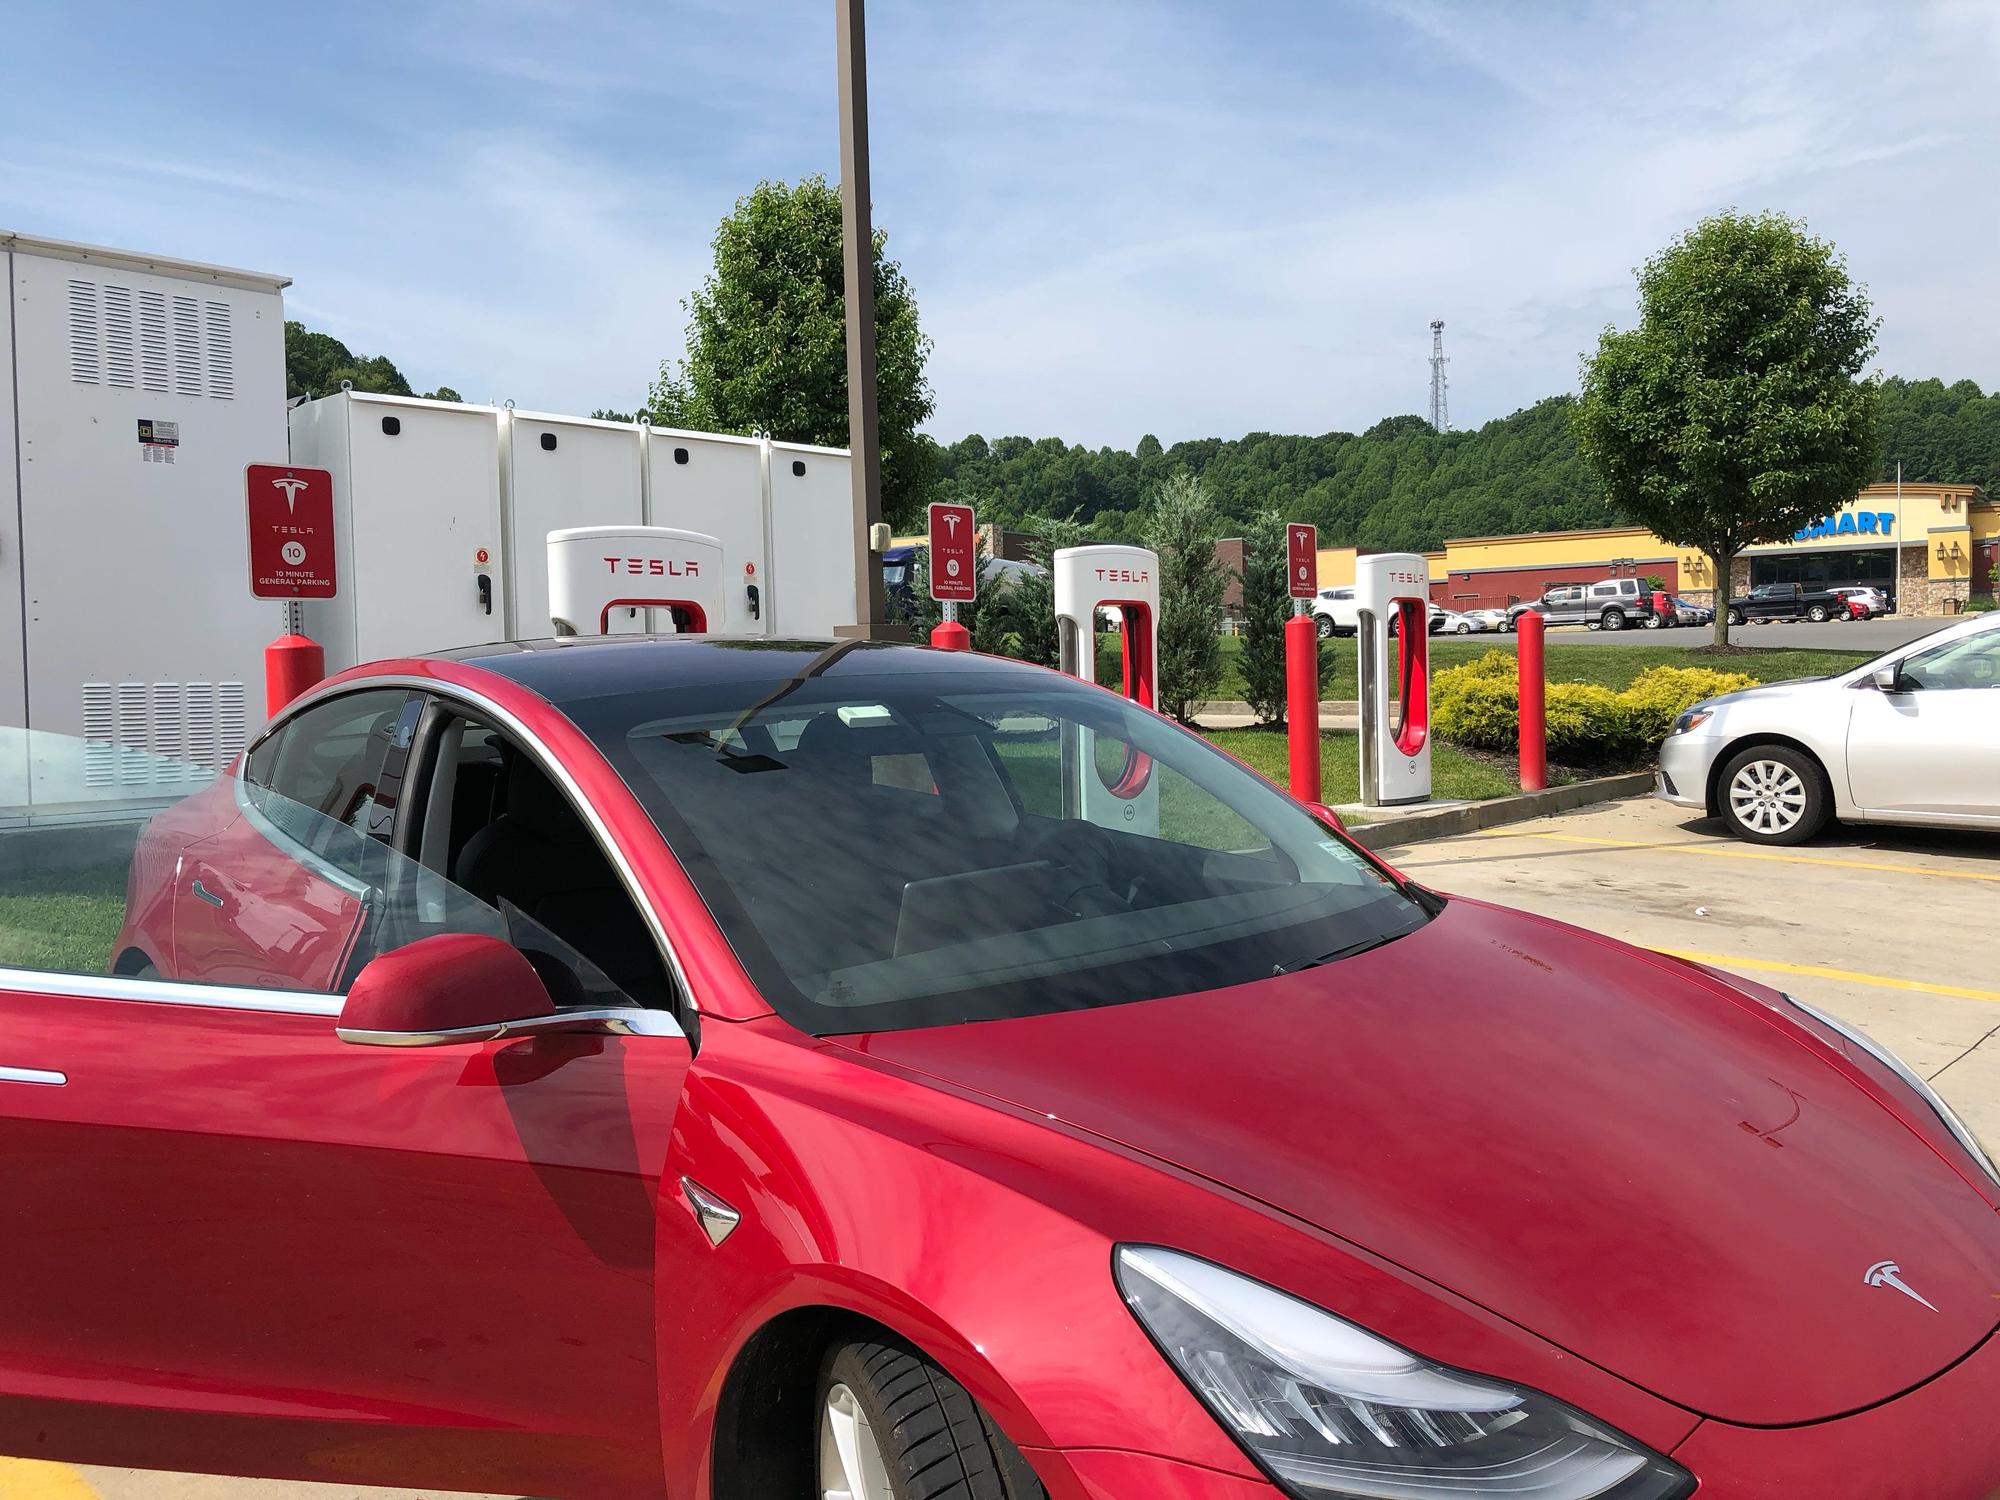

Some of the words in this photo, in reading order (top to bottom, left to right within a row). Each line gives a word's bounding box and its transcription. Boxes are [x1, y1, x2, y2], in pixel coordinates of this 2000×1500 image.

[272, 525, 314, 535] TESLA
[287, 548, 301, 558] 10
[603, 557, 699, 577] TESLA
[259, 577, 295, 585] GENERAL
[1095, 569, 1148, 583] TESLA
[1388, 572, 1424, 583] TESLA
